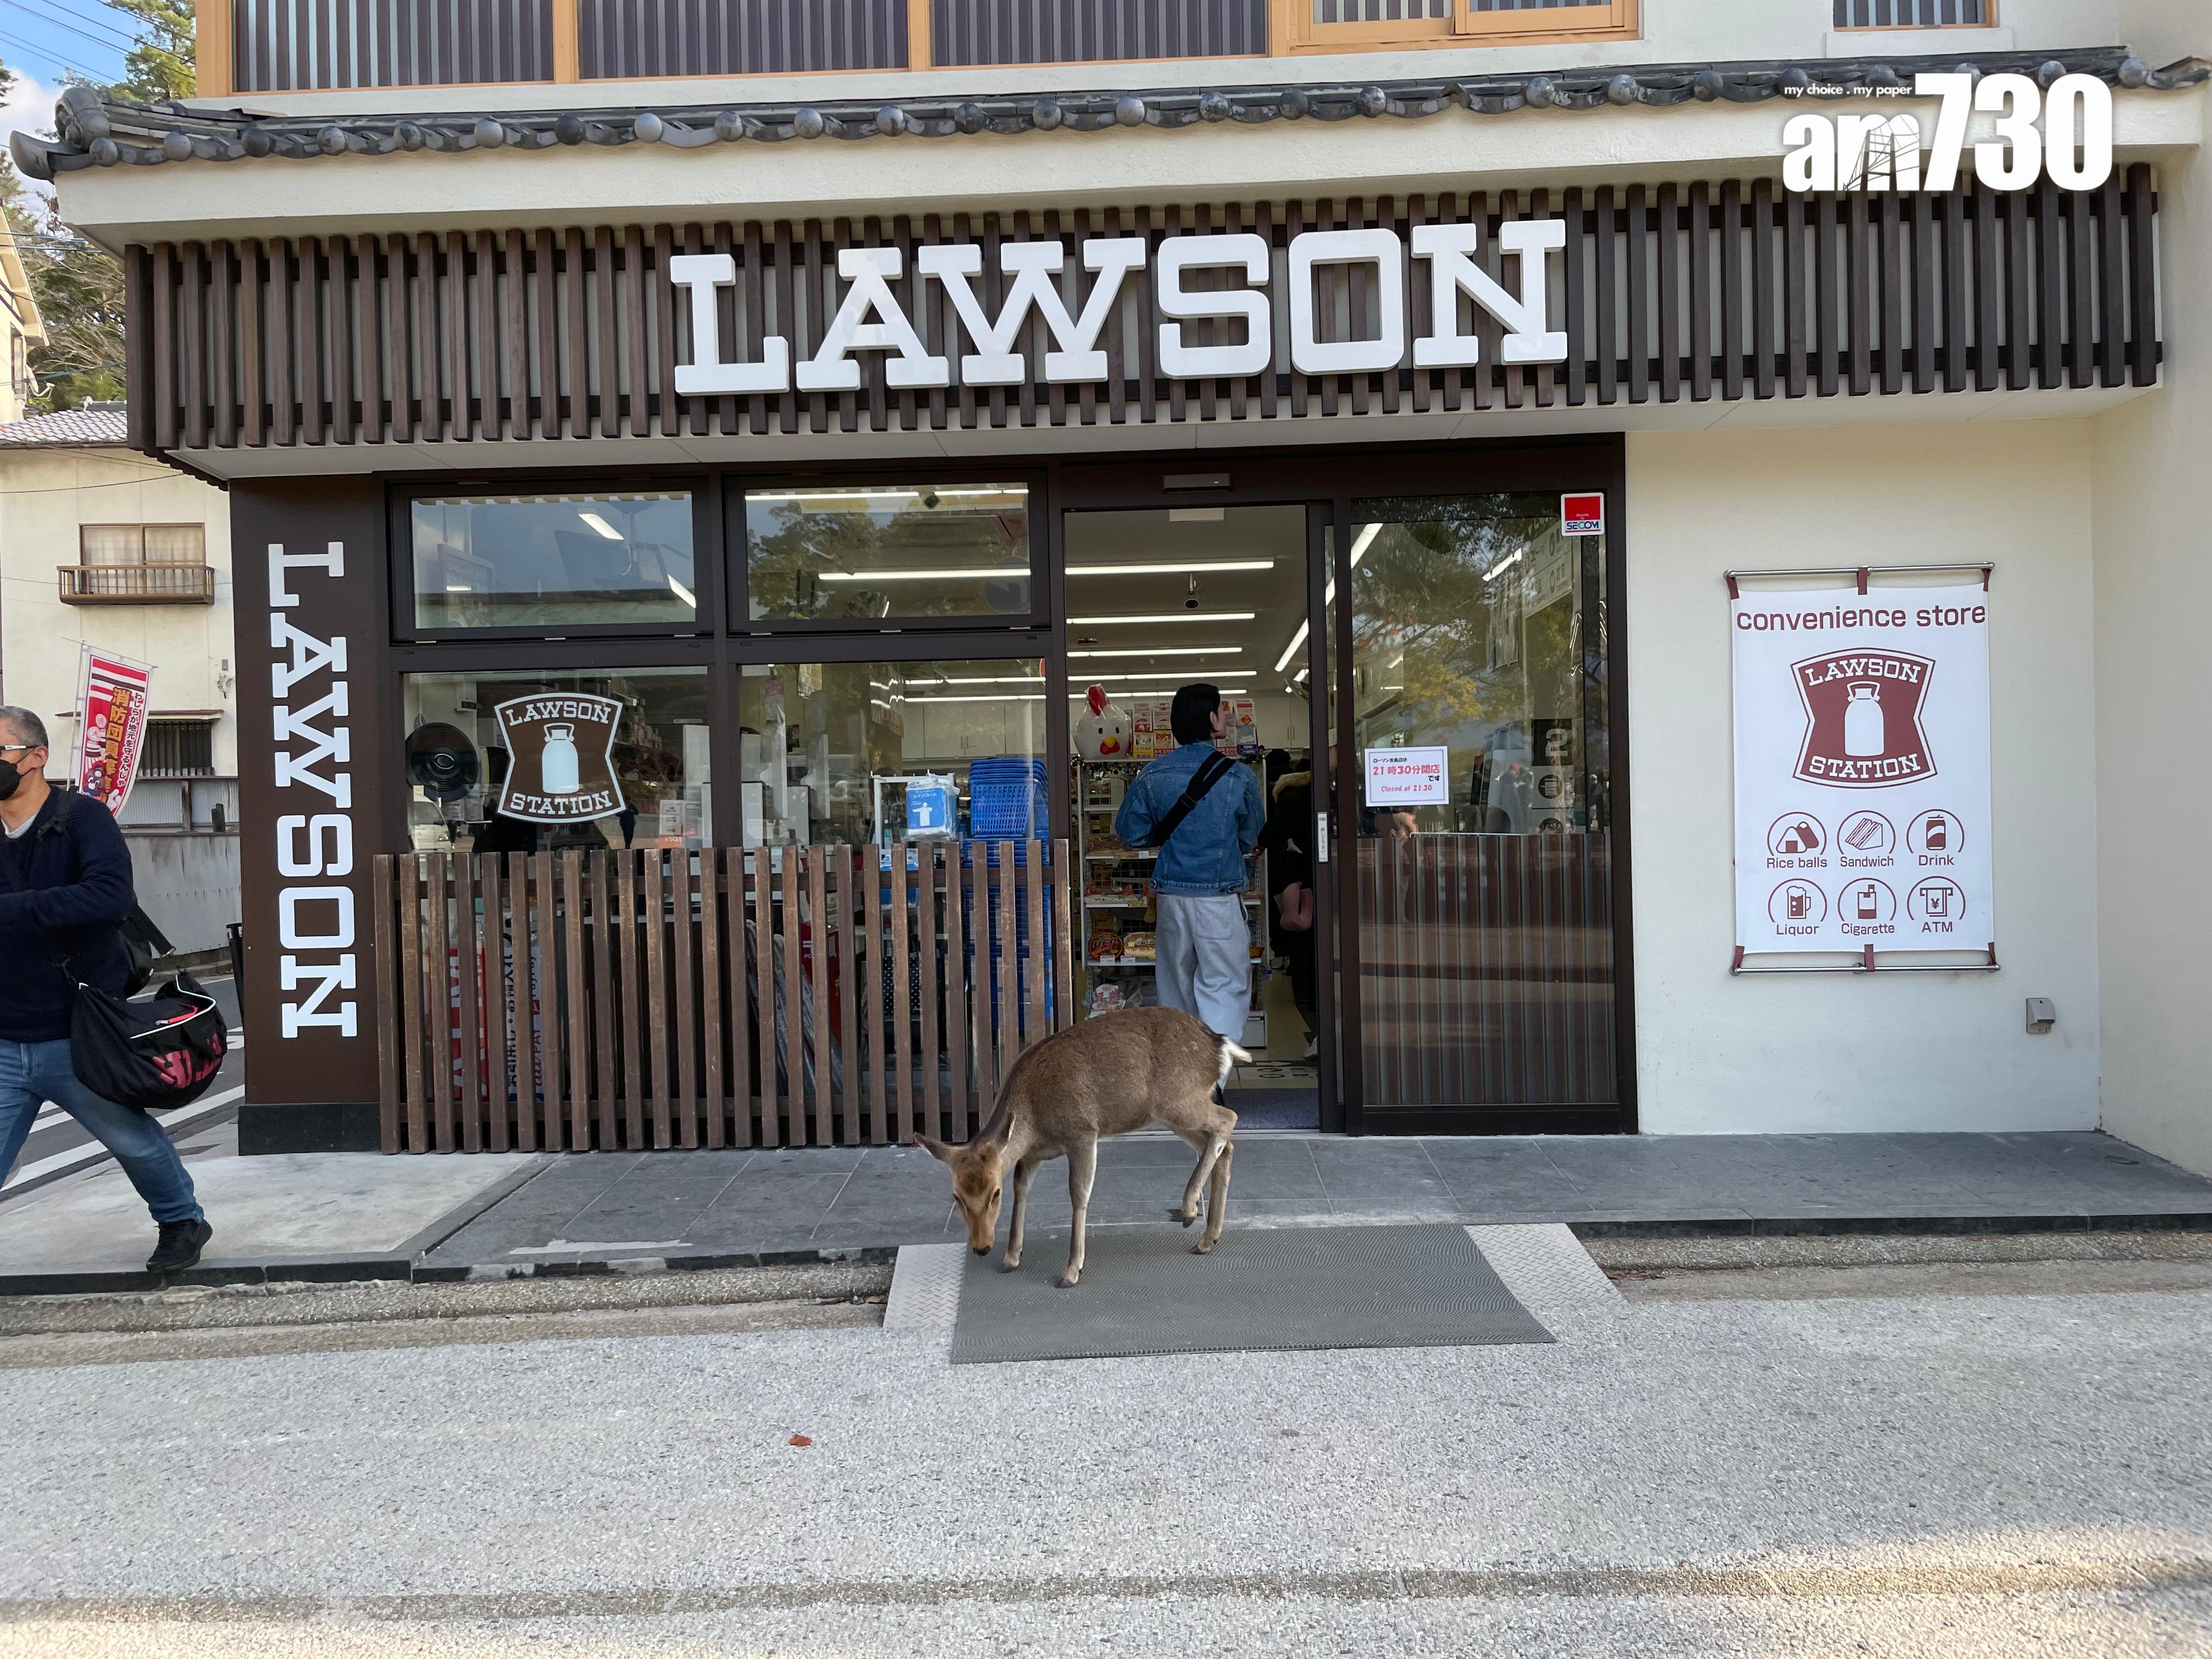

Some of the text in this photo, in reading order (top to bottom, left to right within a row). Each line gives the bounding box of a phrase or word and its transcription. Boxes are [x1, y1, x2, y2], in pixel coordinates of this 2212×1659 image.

[670, 218, 1567, 395] LAWSON
[1566, 521, 1599, 530] SECOM
[1736, 605, 1986, 631] convenience store
[1804, 658, 1921, 686] LAWSON
[505, 701, 612, 726] LAWSON
[1809, 753, 1921, 779] STATION
[268, 541, 358, 1039] LAWSON
[510, 790, 613, 815] STATION
[1767, 856, 1827, 868] Rice balls
[1840, 856, 1894, 867] Sandwich
[1918, 855, 1955, 866] Drink
[1776, 924, 1819, 936] Liquor
[1841, 923, 1895, 935] Cigarette
[1922, 922, 1953, 933] ATM
